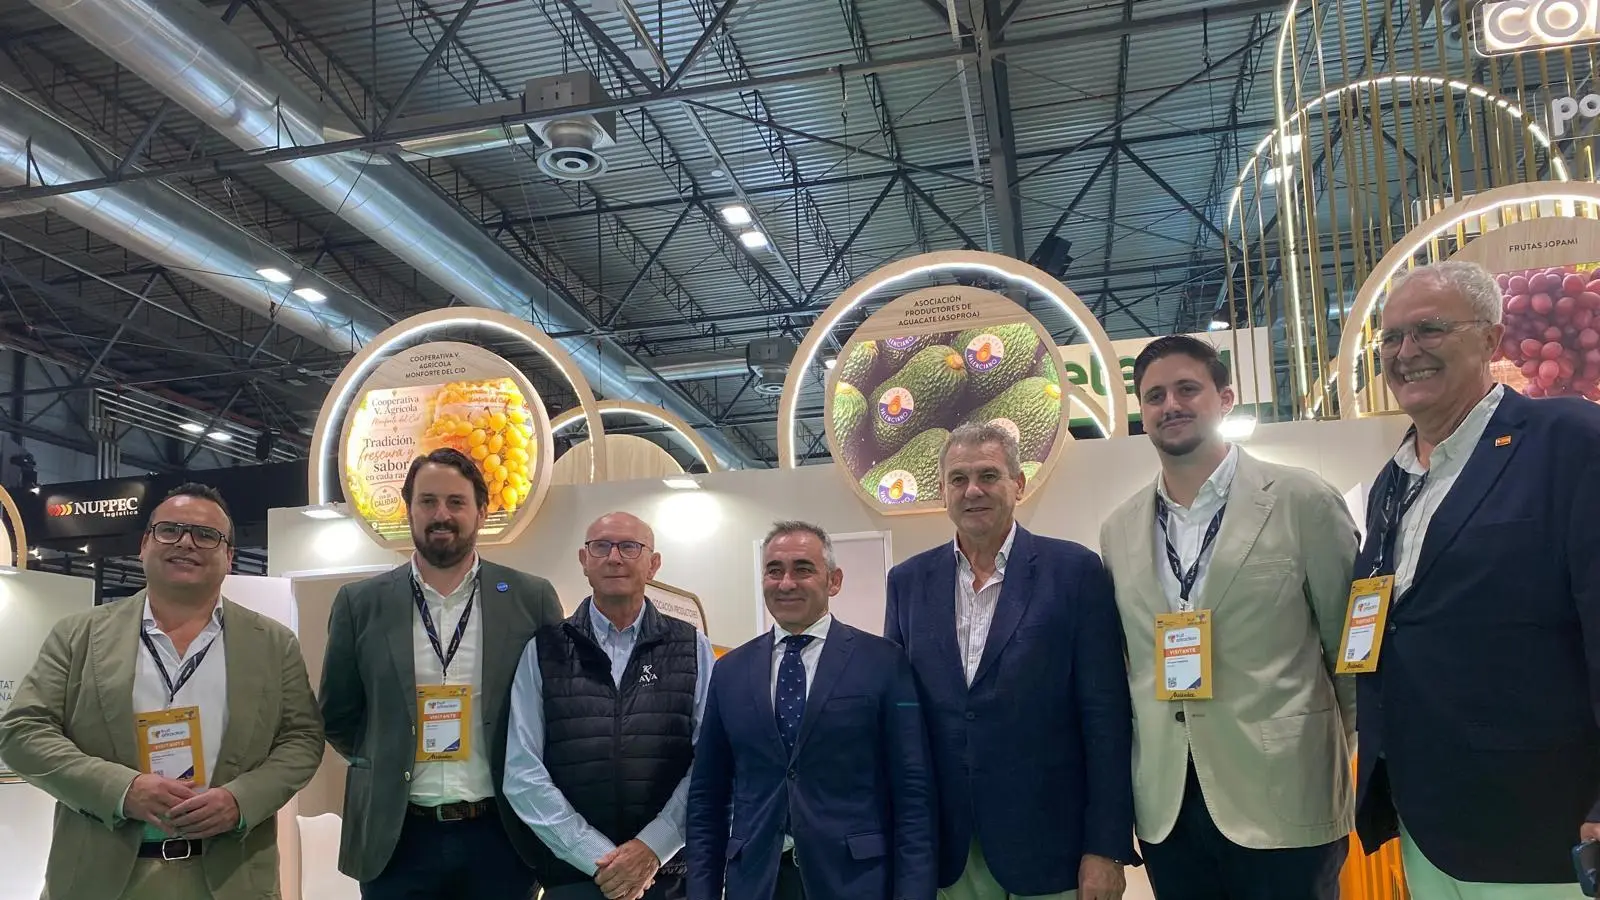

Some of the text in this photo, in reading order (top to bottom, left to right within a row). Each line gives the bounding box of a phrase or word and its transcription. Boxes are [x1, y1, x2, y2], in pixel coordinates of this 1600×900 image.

[1551, 93, 1600, 136] po
[1509, 237, 1578, 252] FRUTAS JOPAMI
[913, 295, 961, 307] ASOCIACIÓN
[904, 304, 960, 317] PRODUCTORES
[898, 311, 980, 326] AGUACATE (ASOPROA)
[409, 353, 454, 363] COOPERATIVA
[405, 369, 441, 378] MONFORTE
[371, 395, 419, 408] Cooperativa
[373, 407, 382, 415] V.
[363, 434, 416, 448] Tradición,
[373, 459, 410, 472] sabor
[376, 472, 393, 480] cada
[73, 497, 138, 515] NUPPEC
[374, 496, 398, 507] CALIDAD
[1169, 647, 1196, 655] VISITANTE
[639, 673, 658, 683] AVA
